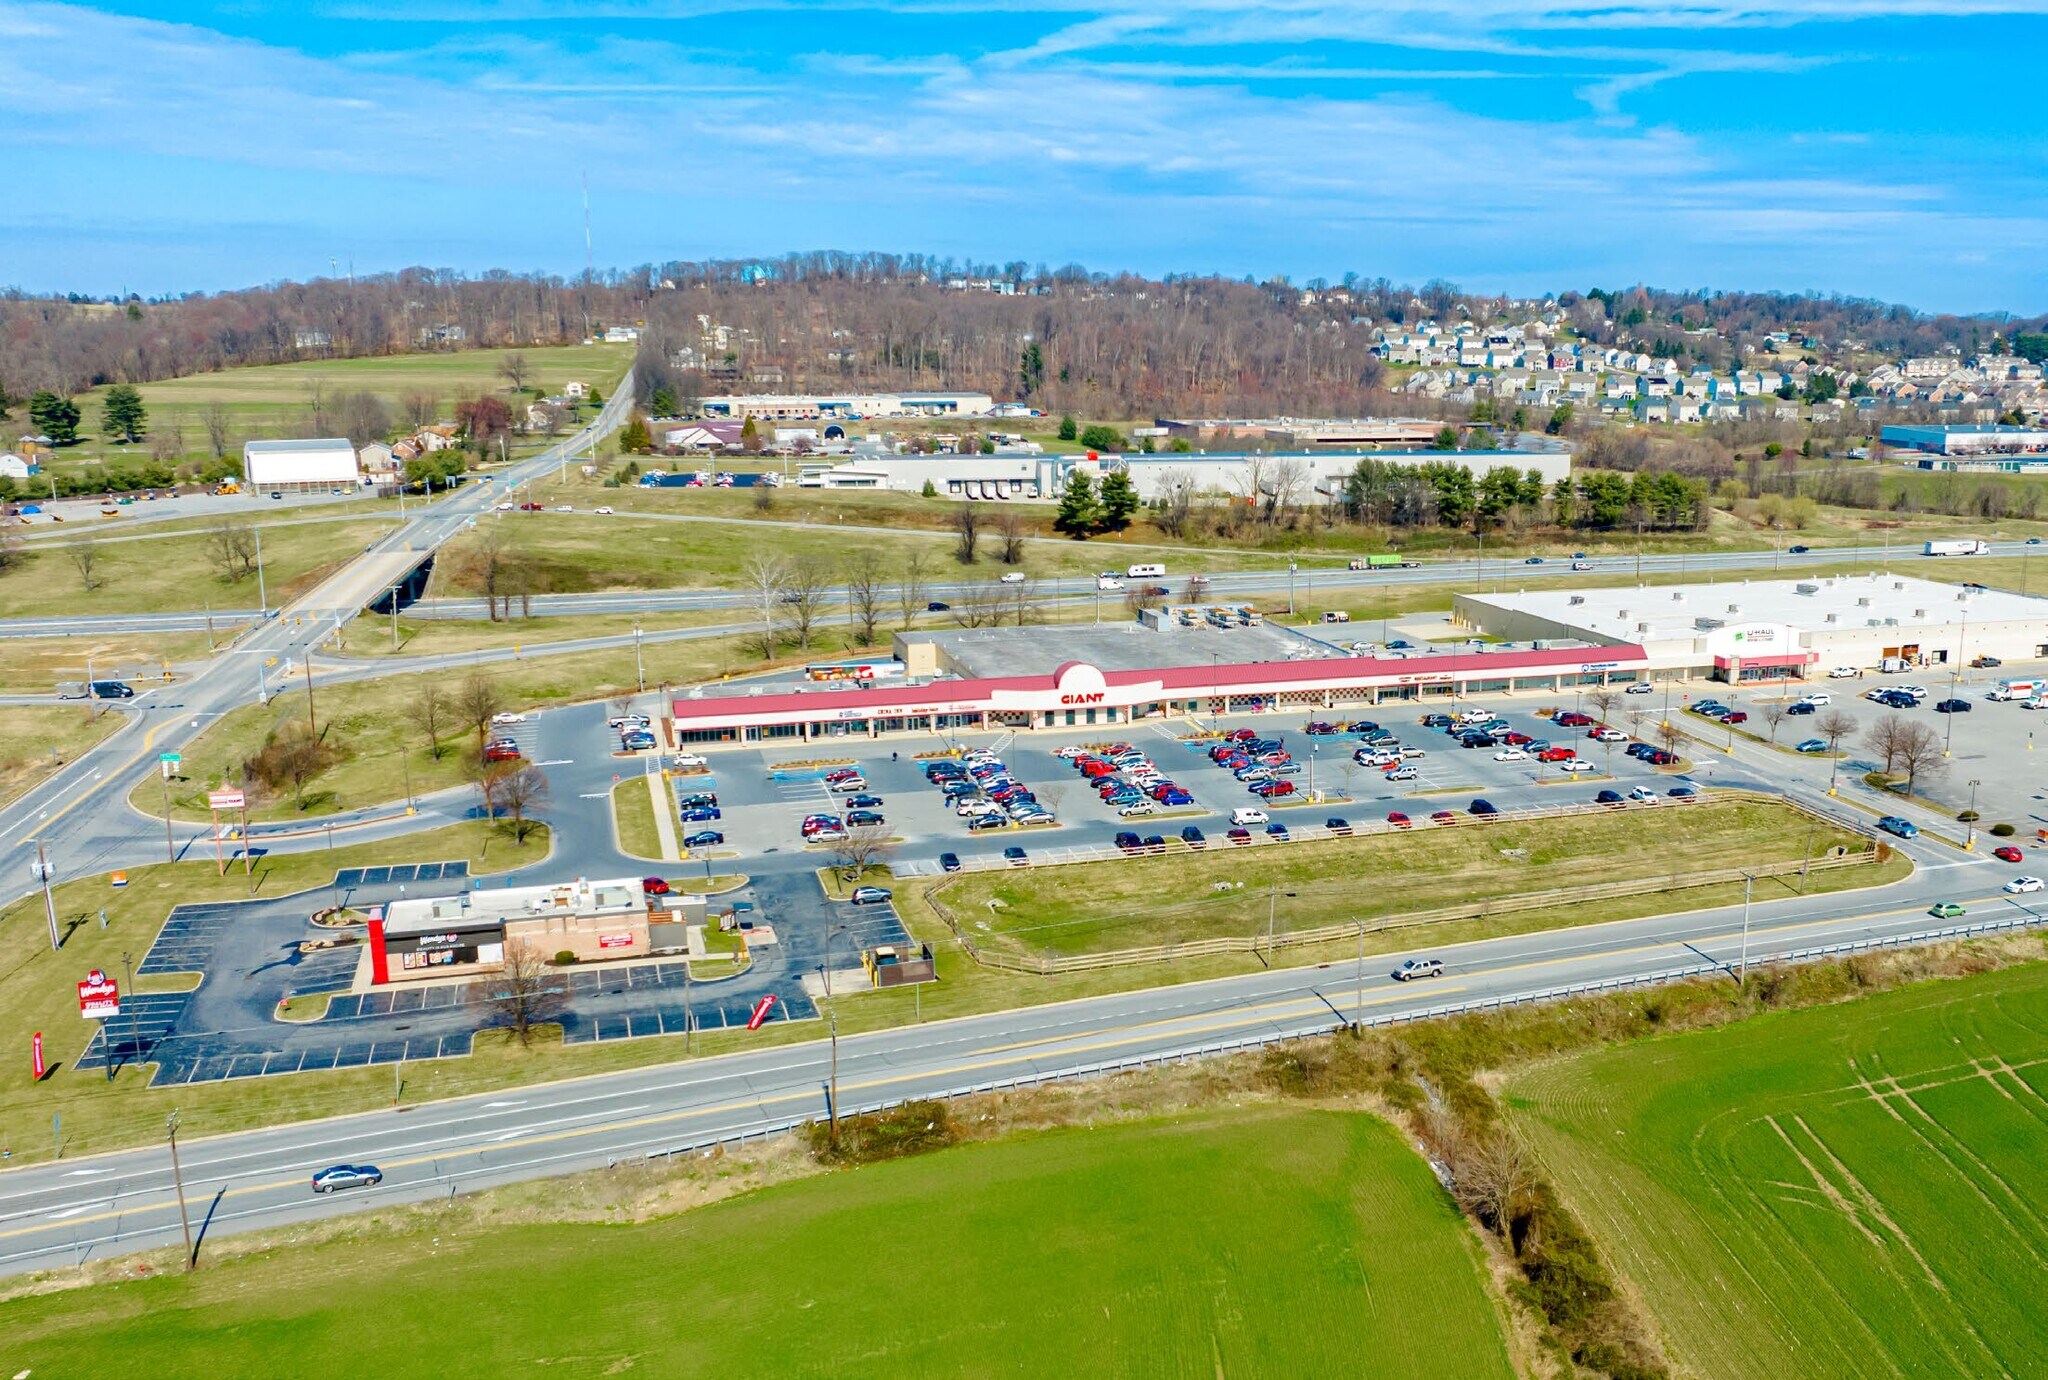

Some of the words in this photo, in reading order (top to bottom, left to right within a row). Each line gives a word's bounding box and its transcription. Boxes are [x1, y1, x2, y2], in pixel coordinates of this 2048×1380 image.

[1061, 693, 1104, 704] GIANT
[420, 934, 446, 946] Wendy's
[80, 982, 116, 998] Wendy's
